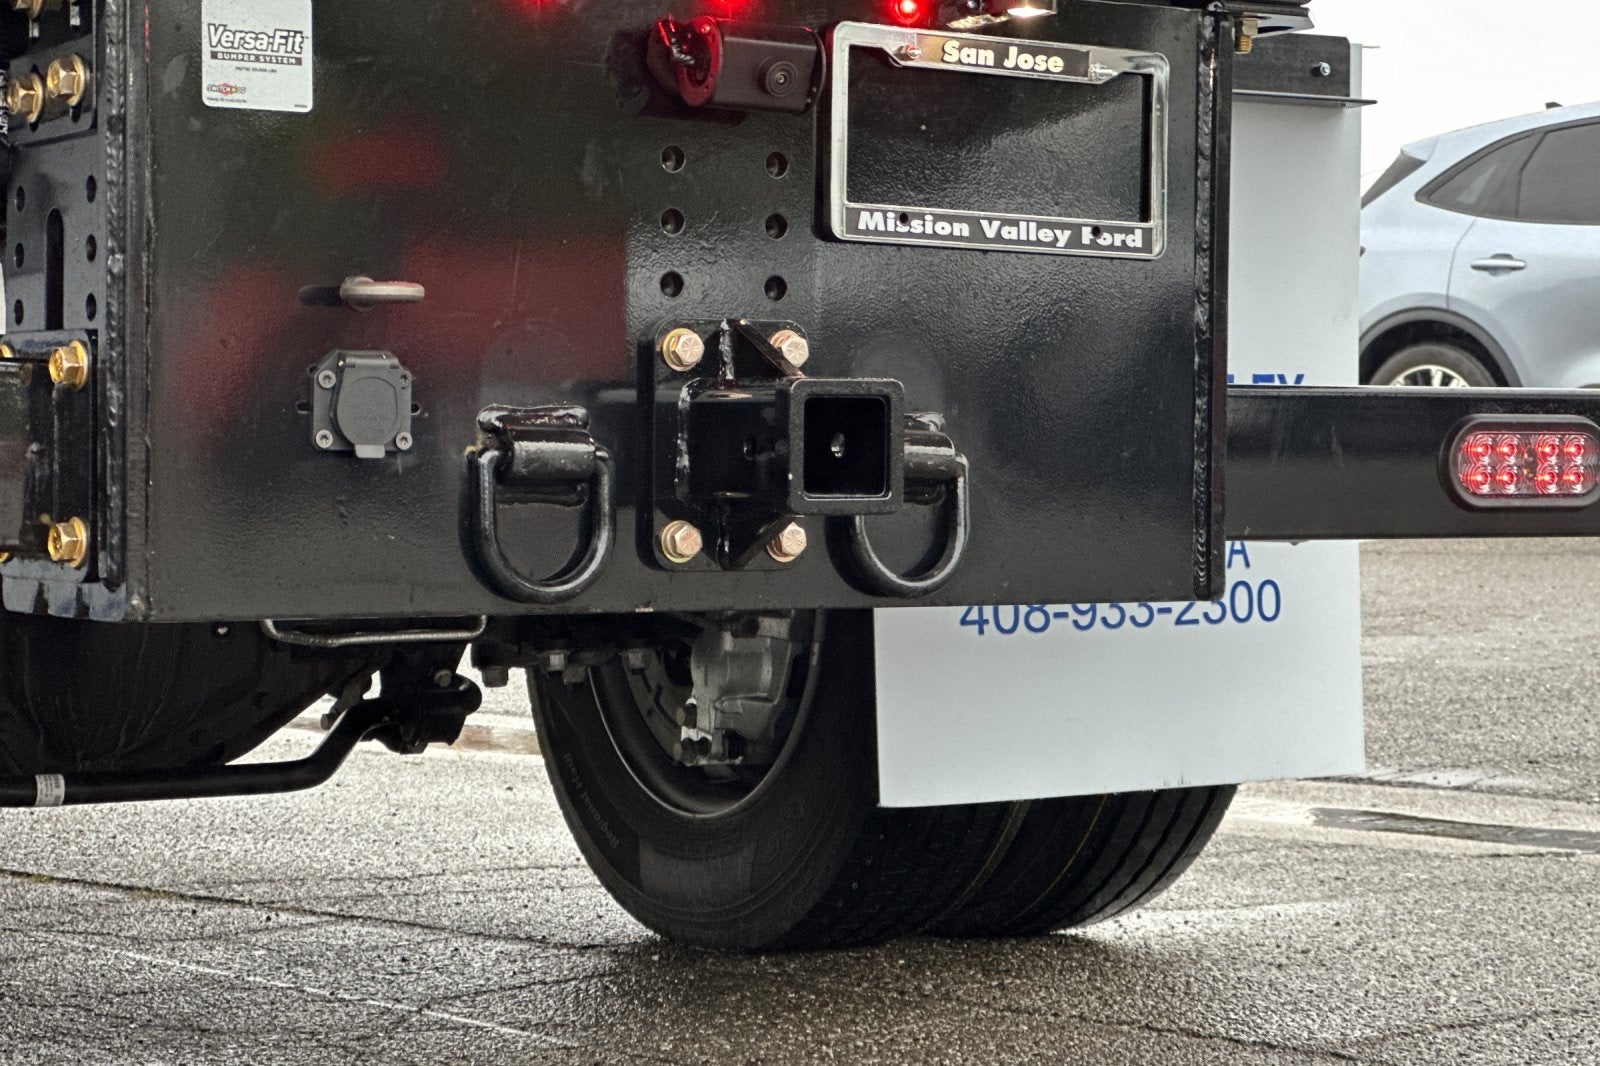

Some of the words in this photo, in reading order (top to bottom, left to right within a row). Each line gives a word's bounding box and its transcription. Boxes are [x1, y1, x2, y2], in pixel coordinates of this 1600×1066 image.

[217, 52, 256, 62] BUMPER
[259, 55, 296, 65] SYSTEM
[943, 40, 994, 66] San
[1003, 46, 1064, 73] Jose
[858, 210, 970, 237] Mission
[980, 219, 1072, 248] Valley
[1081, 226, 1143, 248] Ford
